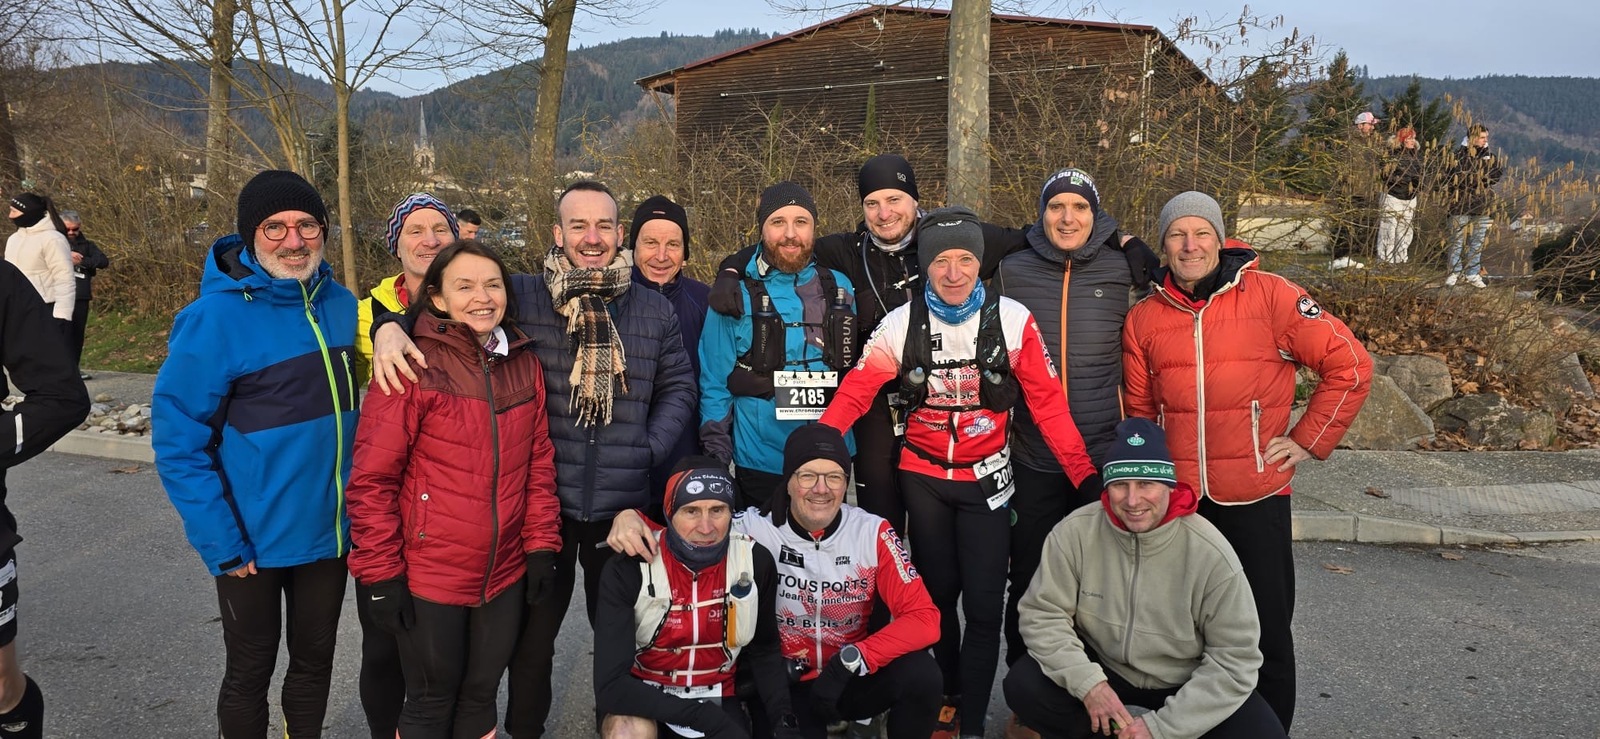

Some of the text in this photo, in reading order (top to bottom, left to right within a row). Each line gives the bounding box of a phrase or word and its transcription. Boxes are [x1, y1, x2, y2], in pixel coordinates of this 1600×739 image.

[843, 316, 853, 367] KIPRUN
[789, 388, 826, 405] 2185
[779, 590, 804, 602] Jean
